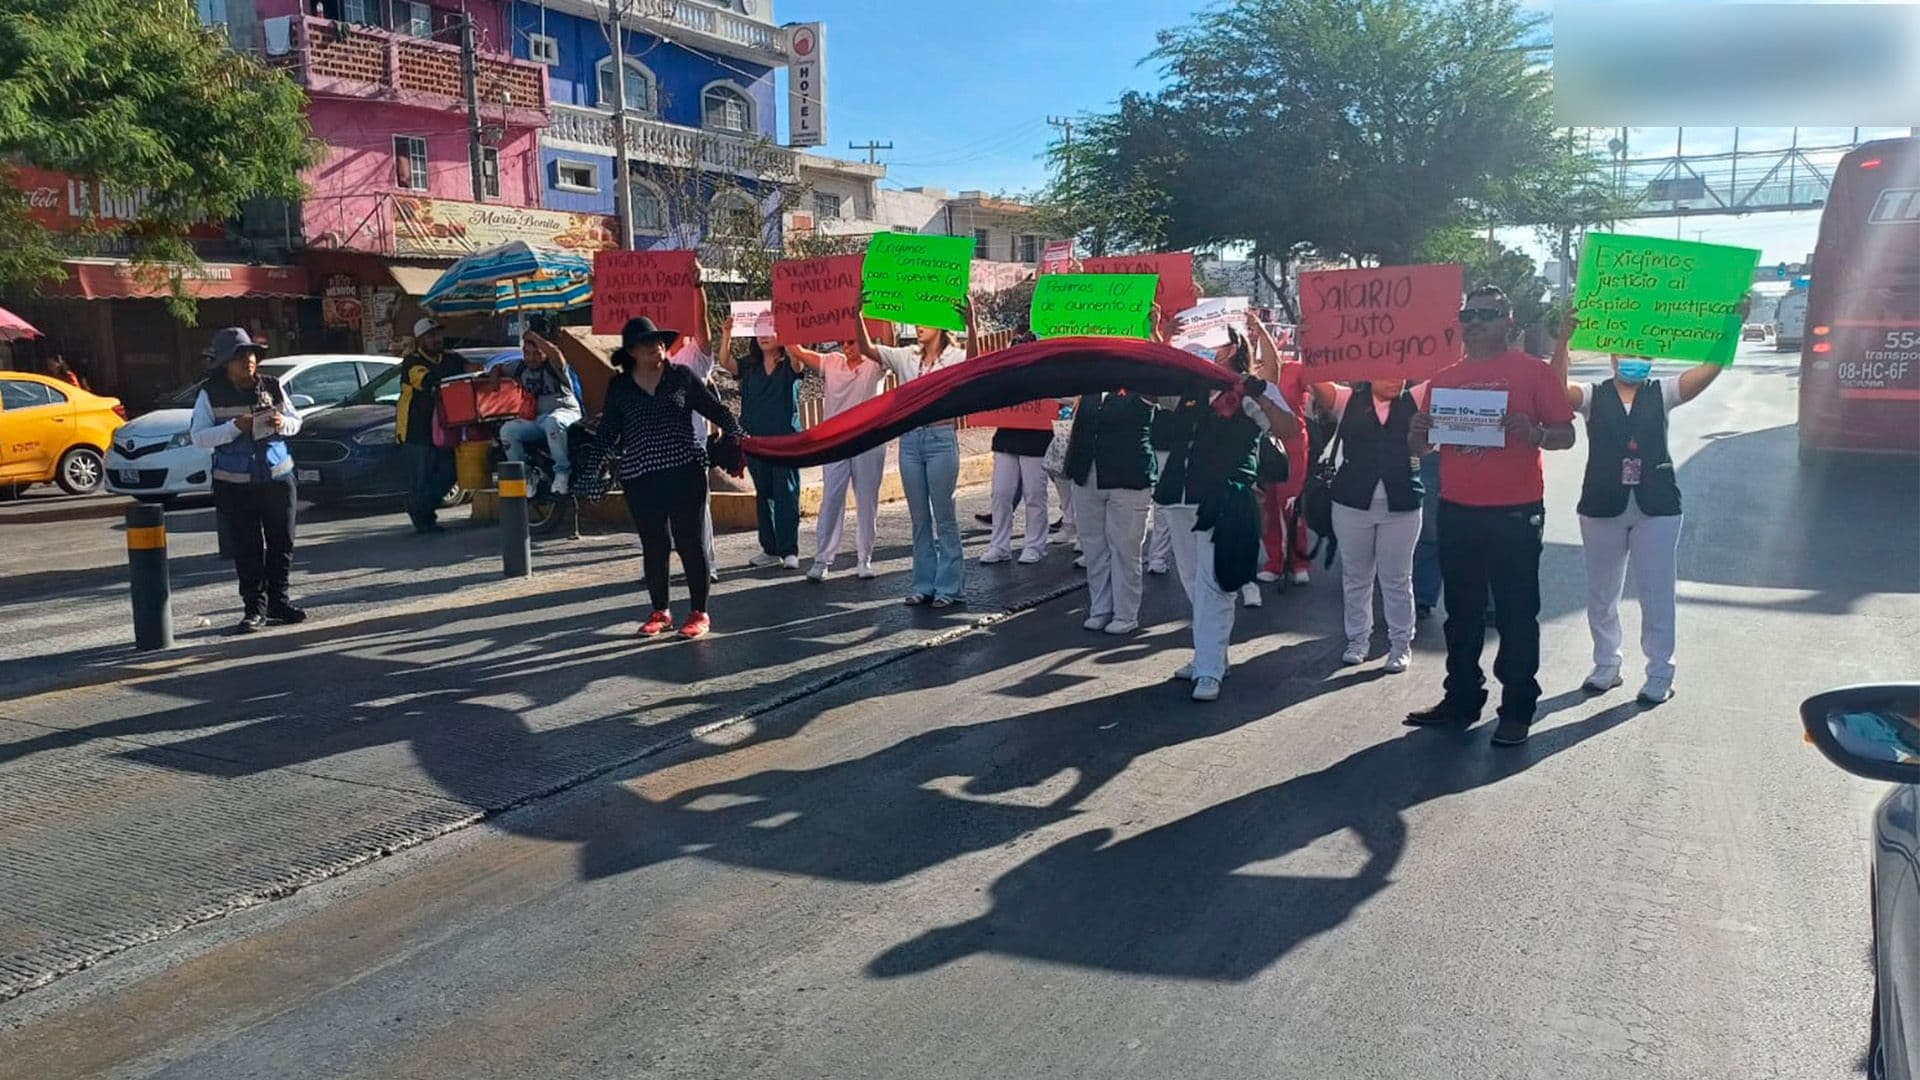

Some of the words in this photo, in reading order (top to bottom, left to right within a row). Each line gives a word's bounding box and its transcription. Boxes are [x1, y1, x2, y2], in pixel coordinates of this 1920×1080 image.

[519, 214, 560, 230] Bonita
[1596, 245, 1696, 272] Exigimos
[656, 271, 693, 287] PARA
[790, 272, 858, 294] MATERIAL
[1588, 271, 1659, 296] justicia
[1667, 275, 1686, 290] al
[1041, 298, 1055, 312] de
[1064, 299, 1126, 311] aumento
[1577, 296, 1641, 314] despido
[1579, 317, 1599, 331] de
[1605, 318, 1628, 331] los
[1865, 350, 1920, 362] transpo
